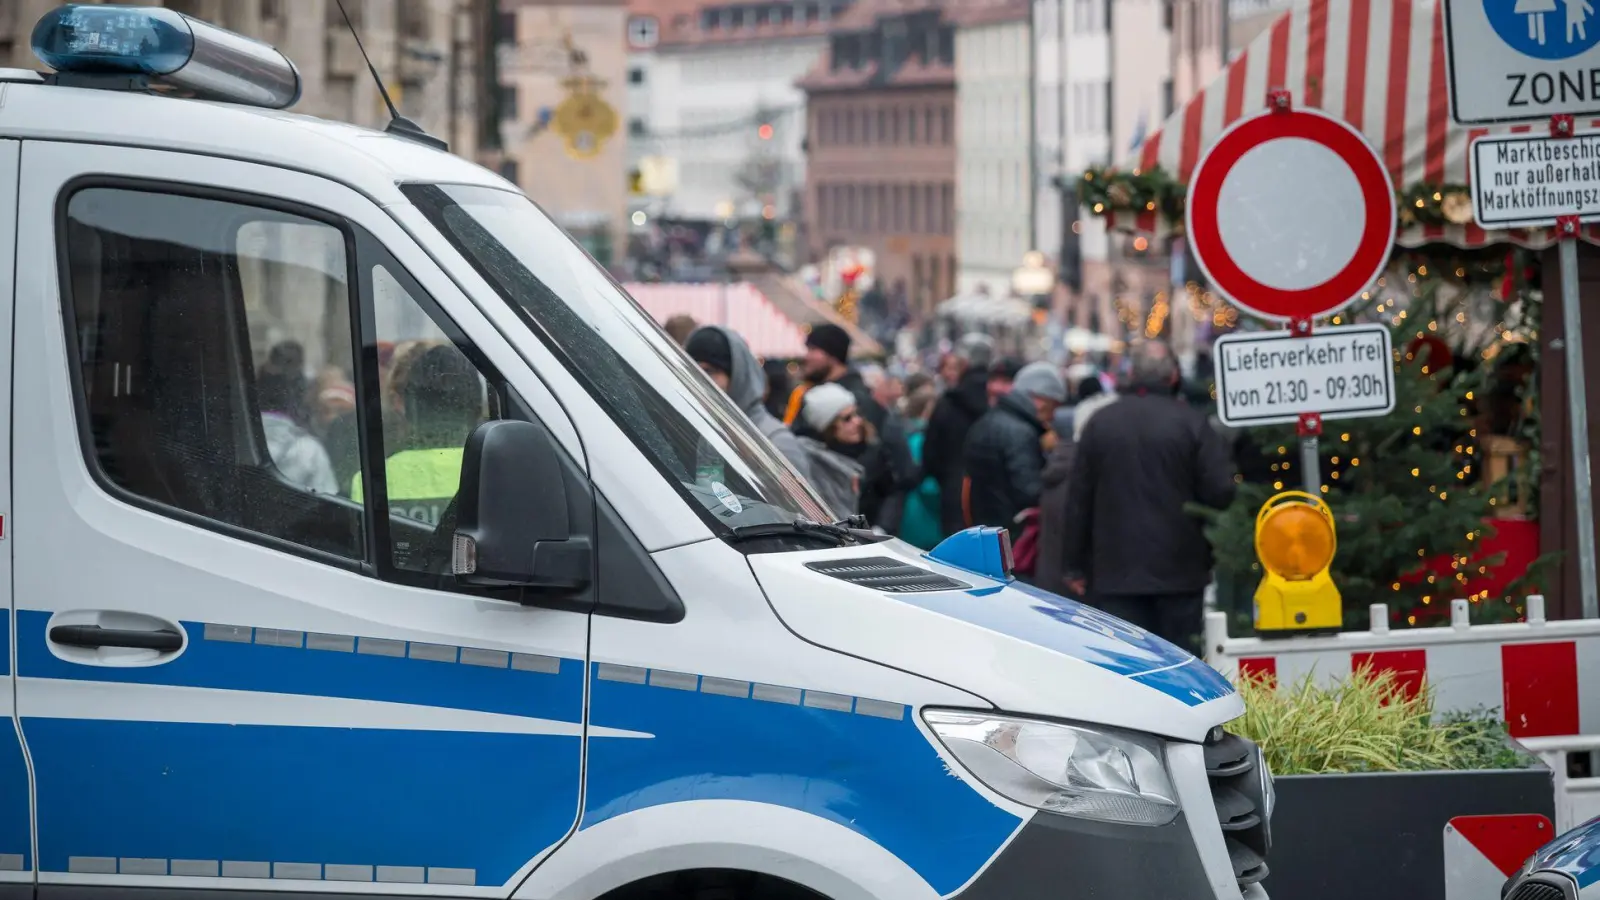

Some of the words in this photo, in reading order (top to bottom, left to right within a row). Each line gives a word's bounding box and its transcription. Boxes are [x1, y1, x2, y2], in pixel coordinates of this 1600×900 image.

[1506, 68, 1600, 107] ZONE
[1494, 169, 1520, 187] nur
[1483, 187, 1600, 211] Marktöffnungsz
[1226, 341, 1348, 372] Lieferverkehr
[1352, 338, 1381, 362] frei
[1228, 388, 1260, 407] von
[1265, 379, 1308, 405] 21:30
[1326, 374, 1383, 400] 09:30h
